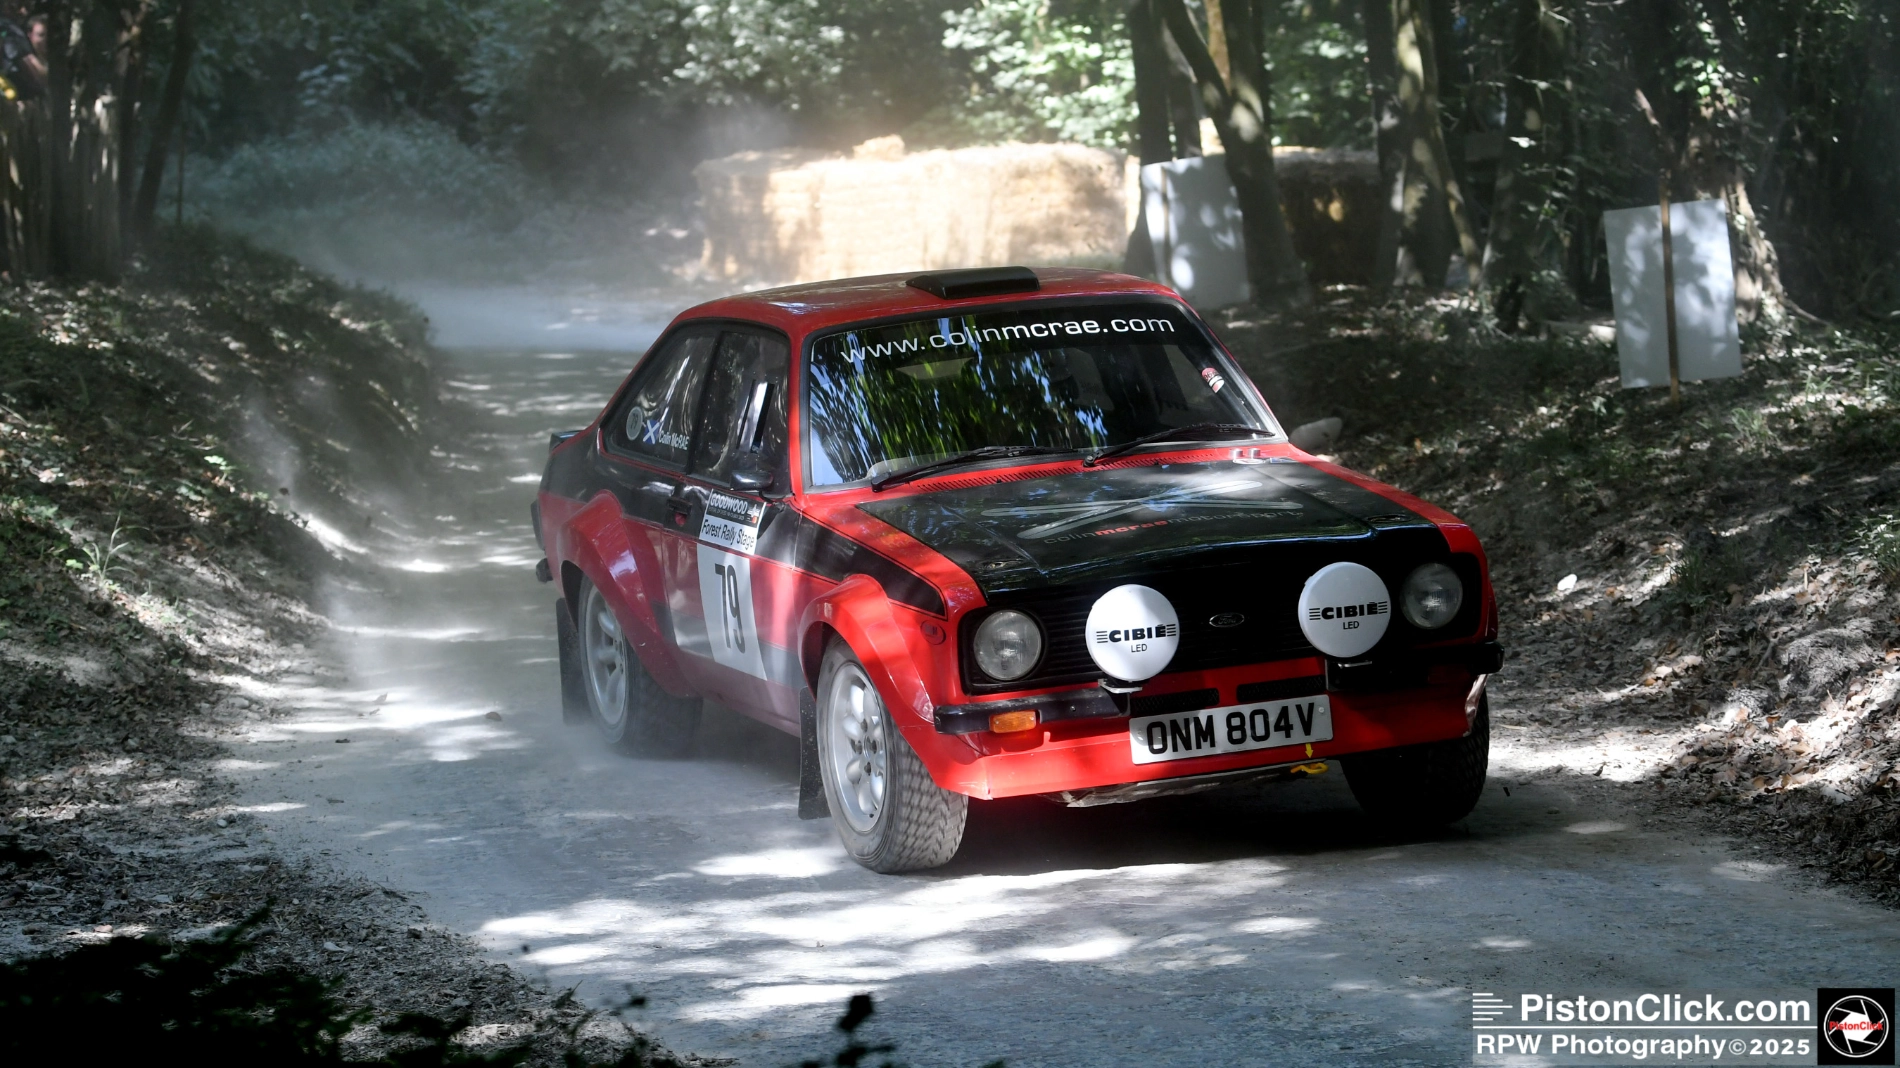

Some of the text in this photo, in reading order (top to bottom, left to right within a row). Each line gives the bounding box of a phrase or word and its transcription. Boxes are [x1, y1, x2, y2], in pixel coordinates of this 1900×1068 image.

[840, 317, 1176, 363] www.colinmcrae.com
[709, 493, 748, 515] GOODWOOD
[702, 519, 756, 551] Forest Rally Stage
[714, 563, 746, 654] 79
[1342, 620, 1360, 630] LED
[1131, 643, 1148, 653] LED
[1146, 702, 1315, 755] ONM 804V
